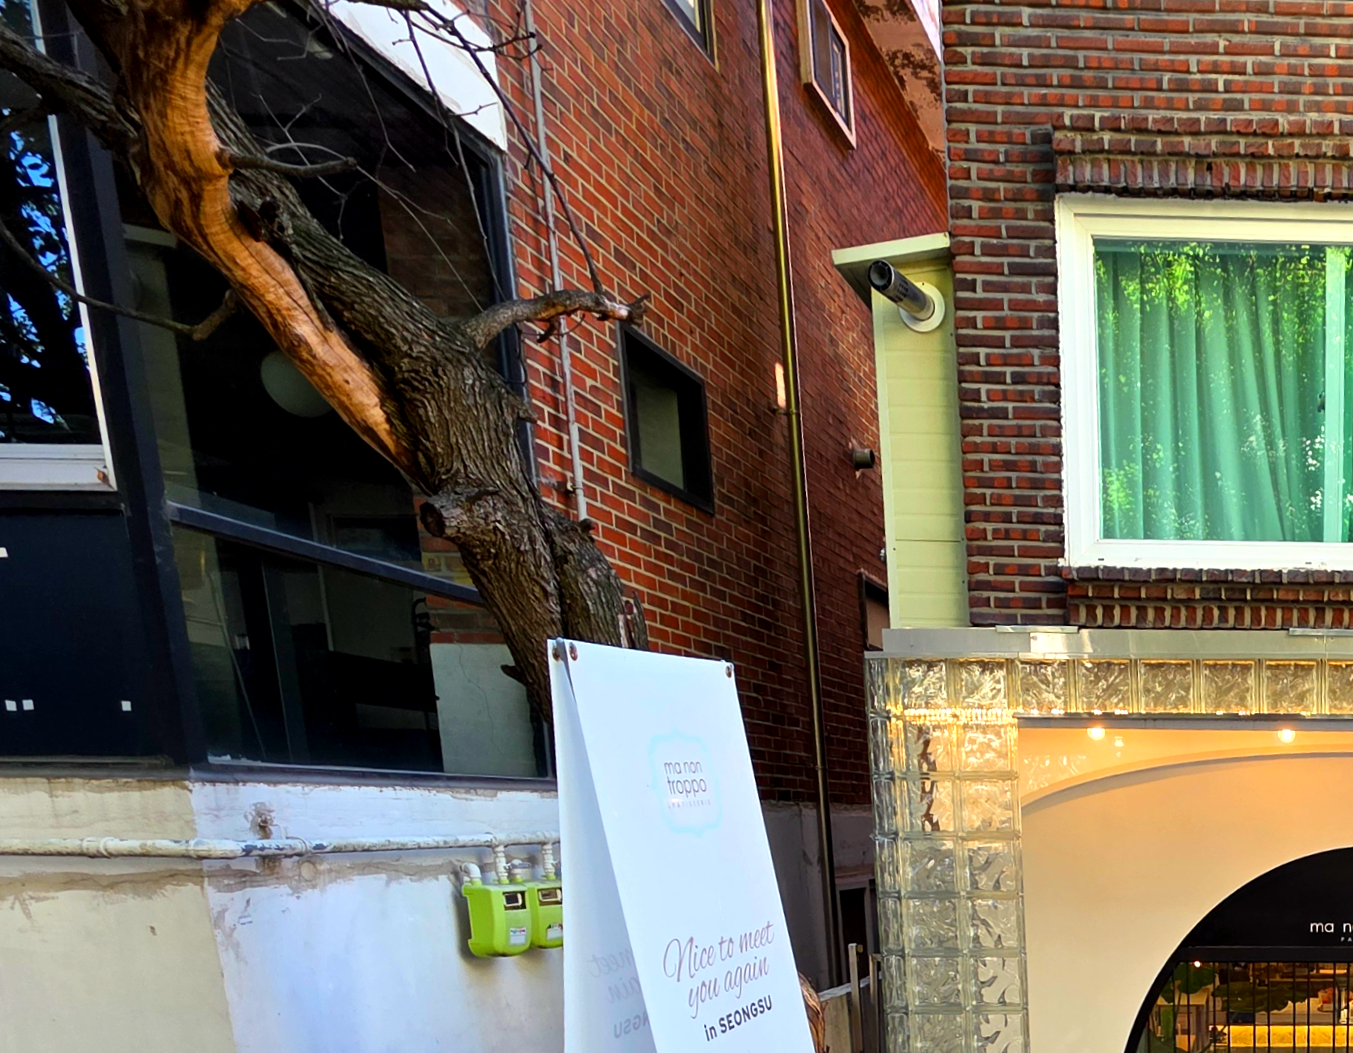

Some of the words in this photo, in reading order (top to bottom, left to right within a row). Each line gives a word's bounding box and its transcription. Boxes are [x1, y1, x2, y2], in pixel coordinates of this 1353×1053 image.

[664, 761, 682, 774] ma
[683, 761, 702, 773] non
[667, 776, 707, 798] troppo
[1310, 922, 1334, 933] ma
[663, 936, 716, 982] Nice
[718, 936, 734, 961] to
[739, 920, 775, 953] meet
[688, 977, 720, 1020] you
[724, 956, 769, 999] again
[704, 1024, 717, 1041] in
[718, 994, 772, 1034] SEONGSU
